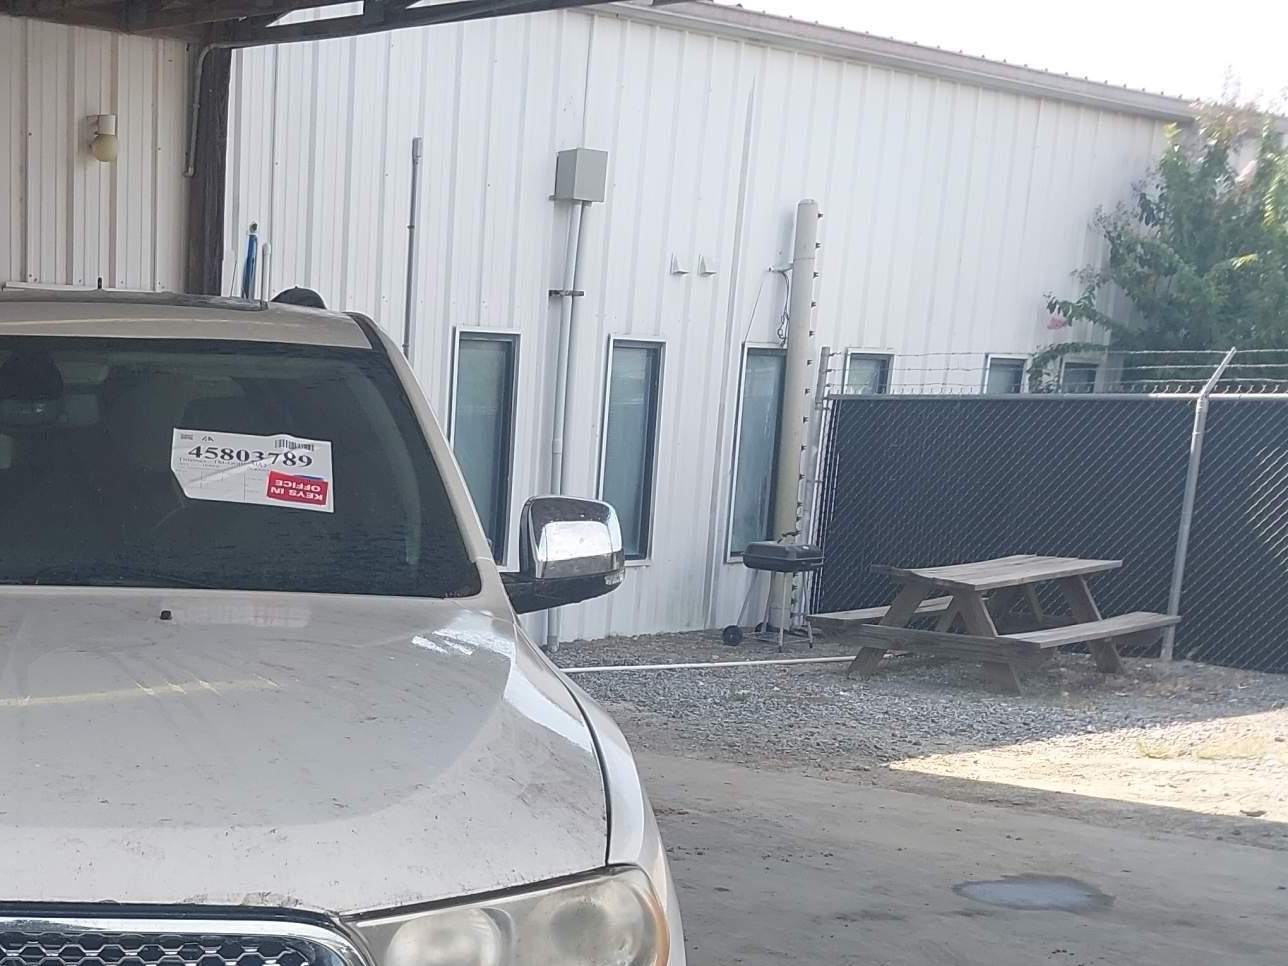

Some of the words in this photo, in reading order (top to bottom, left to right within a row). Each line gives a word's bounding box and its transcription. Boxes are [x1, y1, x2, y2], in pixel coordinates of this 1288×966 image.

[188, 445, 313, 468] 45803789
[270, 486, 285, 495] IN
[275, 479, 321, 492] OFFICE
[289, 489, 324, 501] KEYS
